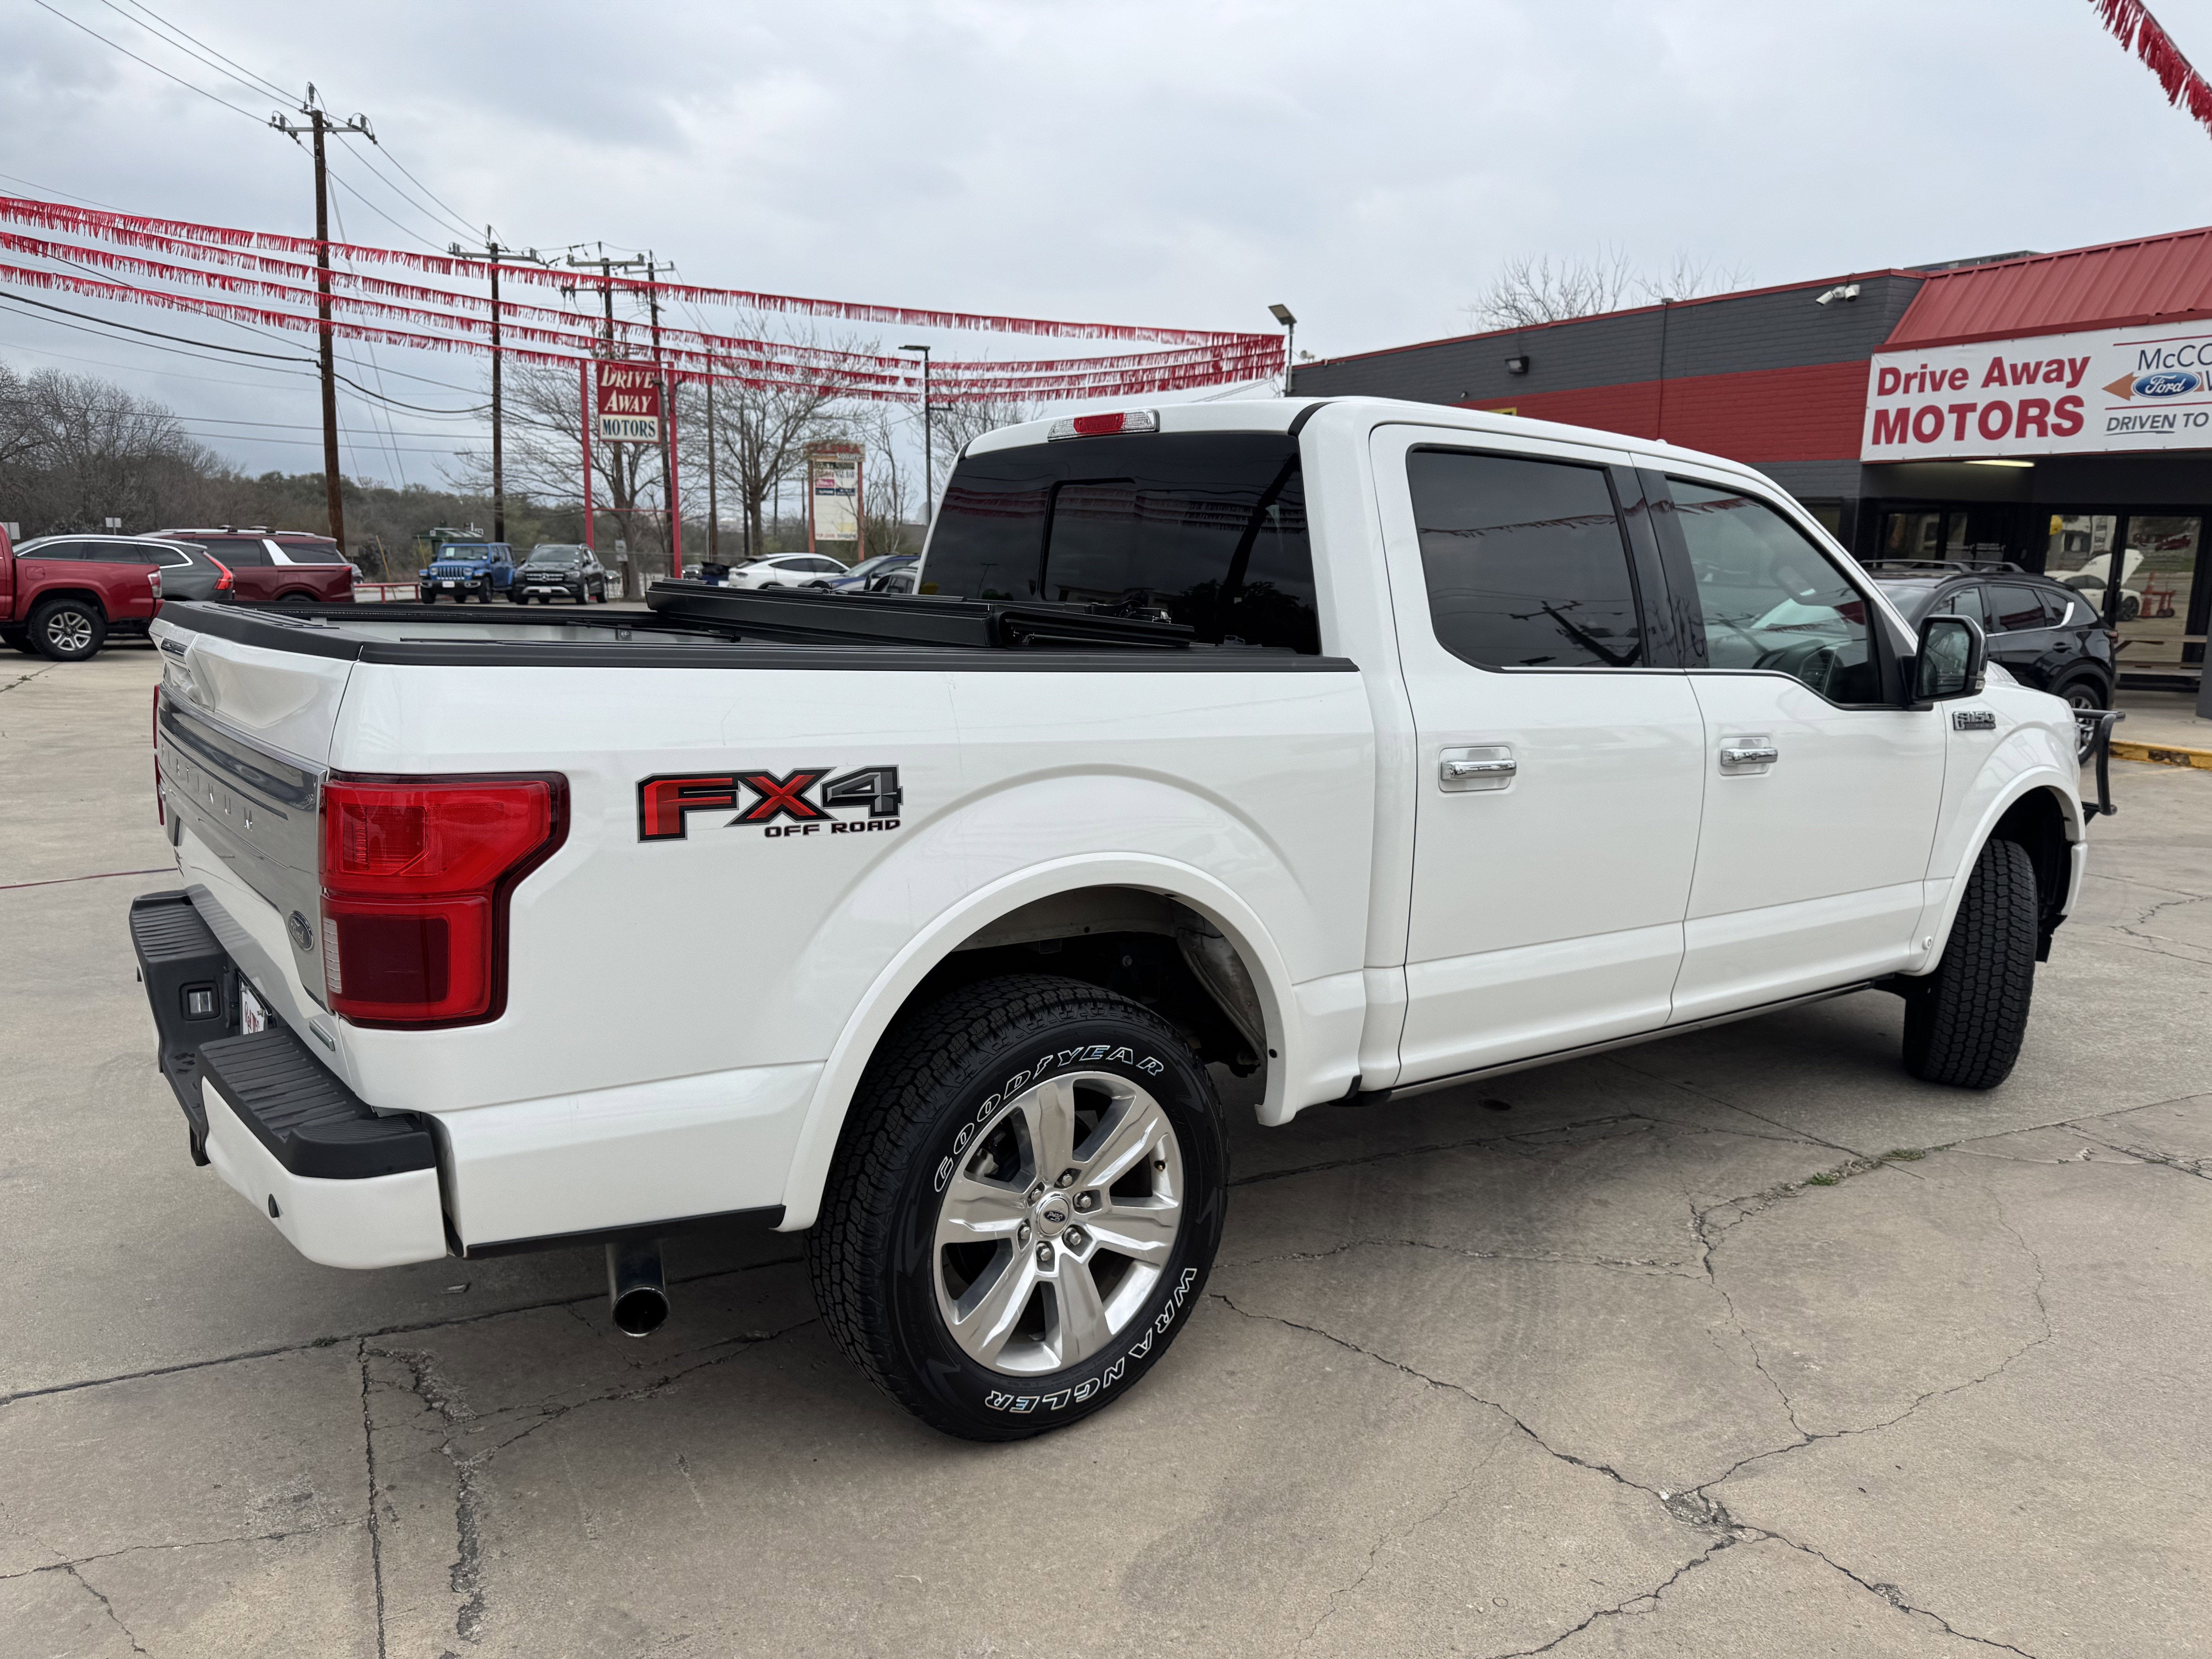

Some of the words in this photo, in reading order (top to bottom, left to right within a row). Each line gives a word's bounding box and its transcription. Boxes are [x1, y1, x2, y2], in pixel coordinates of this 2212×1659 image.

[601, 364, 654, 390] DRIVE
[1877, 363, 1968, 397] Drive
[1981, 356, 2092, 389] Away
[2145, 374, 2186, 394] Ford
[604, 389, 652, 413] AWAY
[603, 419, 656, 438] MOTORS
[1872, 394, 2085, 445] MOTORS
[2106, 413, 2177, 431] DRIVEN
[2183, 412, 2209, 428] TO
[635, 764, 903, 843] FX4
[764, 823, 821, 838] OFF
[830, 819, 901, 835] ROAD
[934, 1045, 1164, 1192] GOODYEAR
[984, 1267, 1197, 1413] WRANGLER
